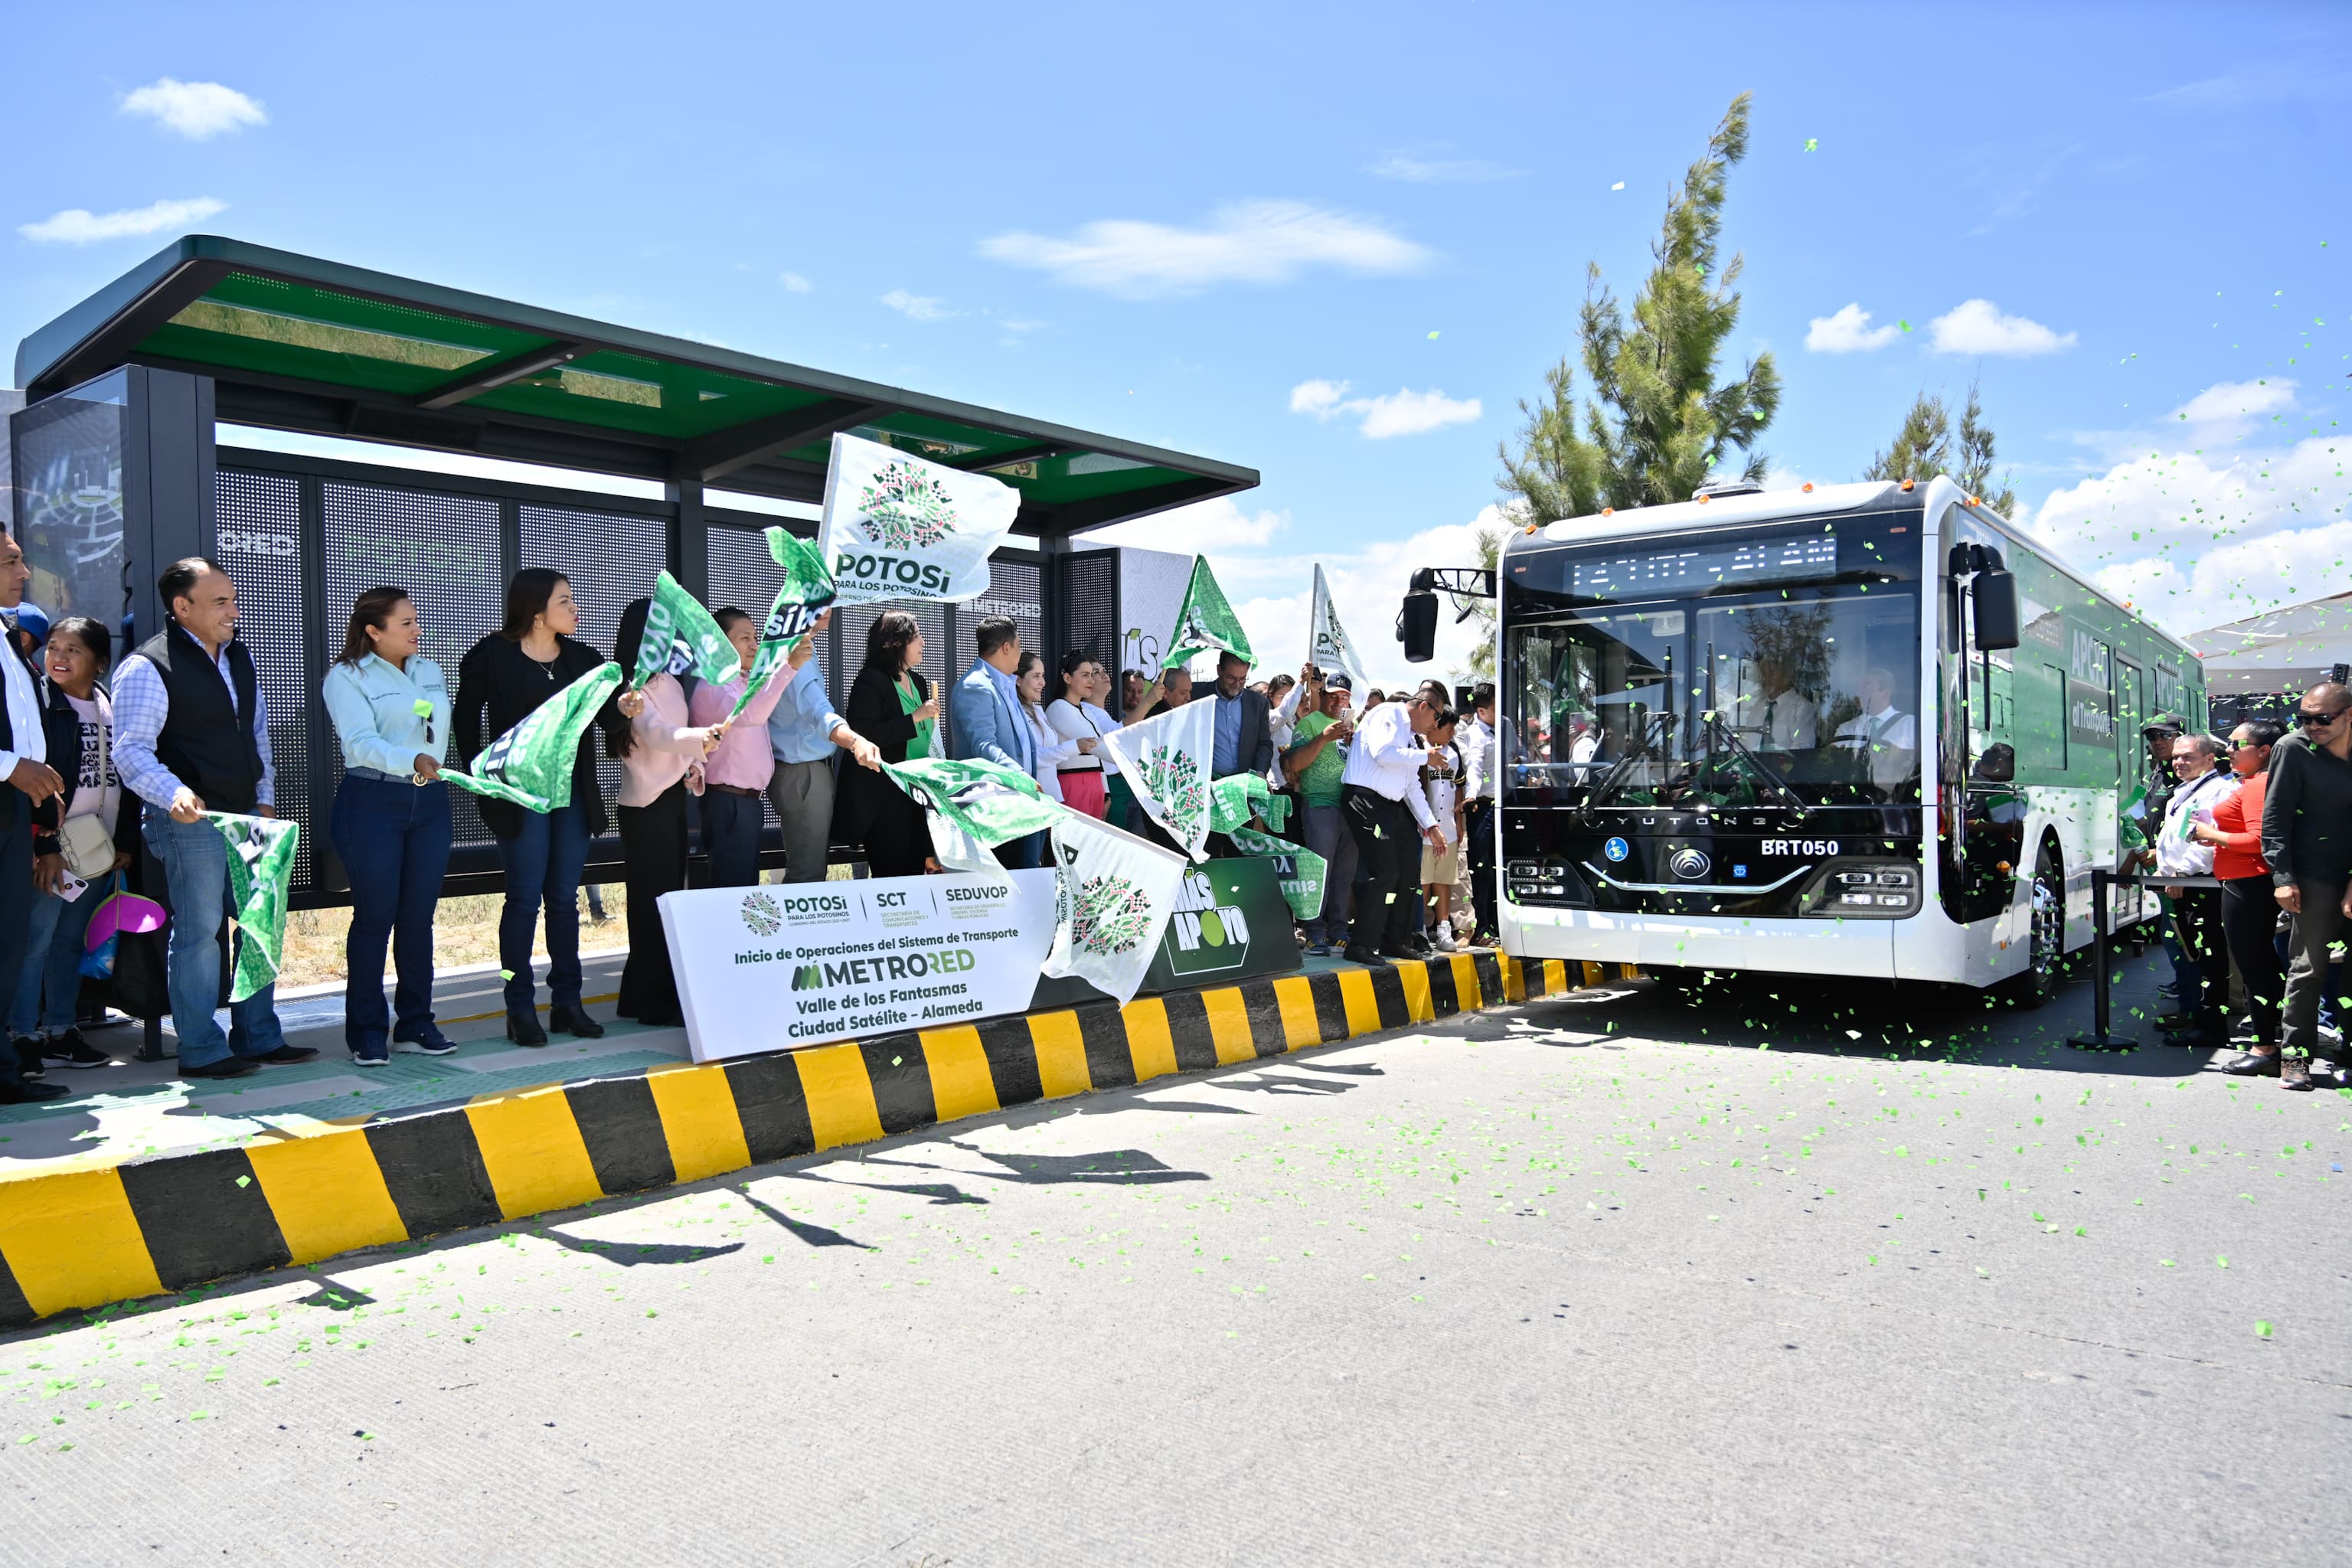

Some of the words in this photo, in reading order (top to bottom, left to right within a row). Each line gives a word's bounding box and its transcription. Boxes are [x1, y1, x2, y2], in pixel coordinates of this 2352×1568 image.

[835, 554, 952, 594] POTOSÍ
[835, 580, 857, 590] PARA
[859, 581, 880, 592] LOS
[1617, 816, 1766, 825] YUTONG
[1761, 840, 1838, 856] BRT050
[784, 895, 848, 913] POTOSÍ
[877, 892, 906, 907] SCT
[946, 886, 1008, 902] SEDUVOP
[1174, 907, 1248, 951] APOYO
[735, 953, 773, 965] Inicio
[776, 949, 792, 961] de
[795, 942, 874, 961] Operaciones
[877, 939, 897, 950] del
[898, 935, 944, 949] Sistema
[947, 933, 961, 944] de
[962, 927, 1019, 942] Transporte
[824, 949, 975, 988] METRORED
[796, 998, 837, 1015] Valle
[841, 995, 861, 1009] de
[864, 991, 886, 1005] los
[890, 983, 968, 1003] Fantasmas
[788, 1016, 846, 1038] Ciudad
[849, 1009, 908, 1030] Satélite
[922, 999, 983, 1020] Alameda
